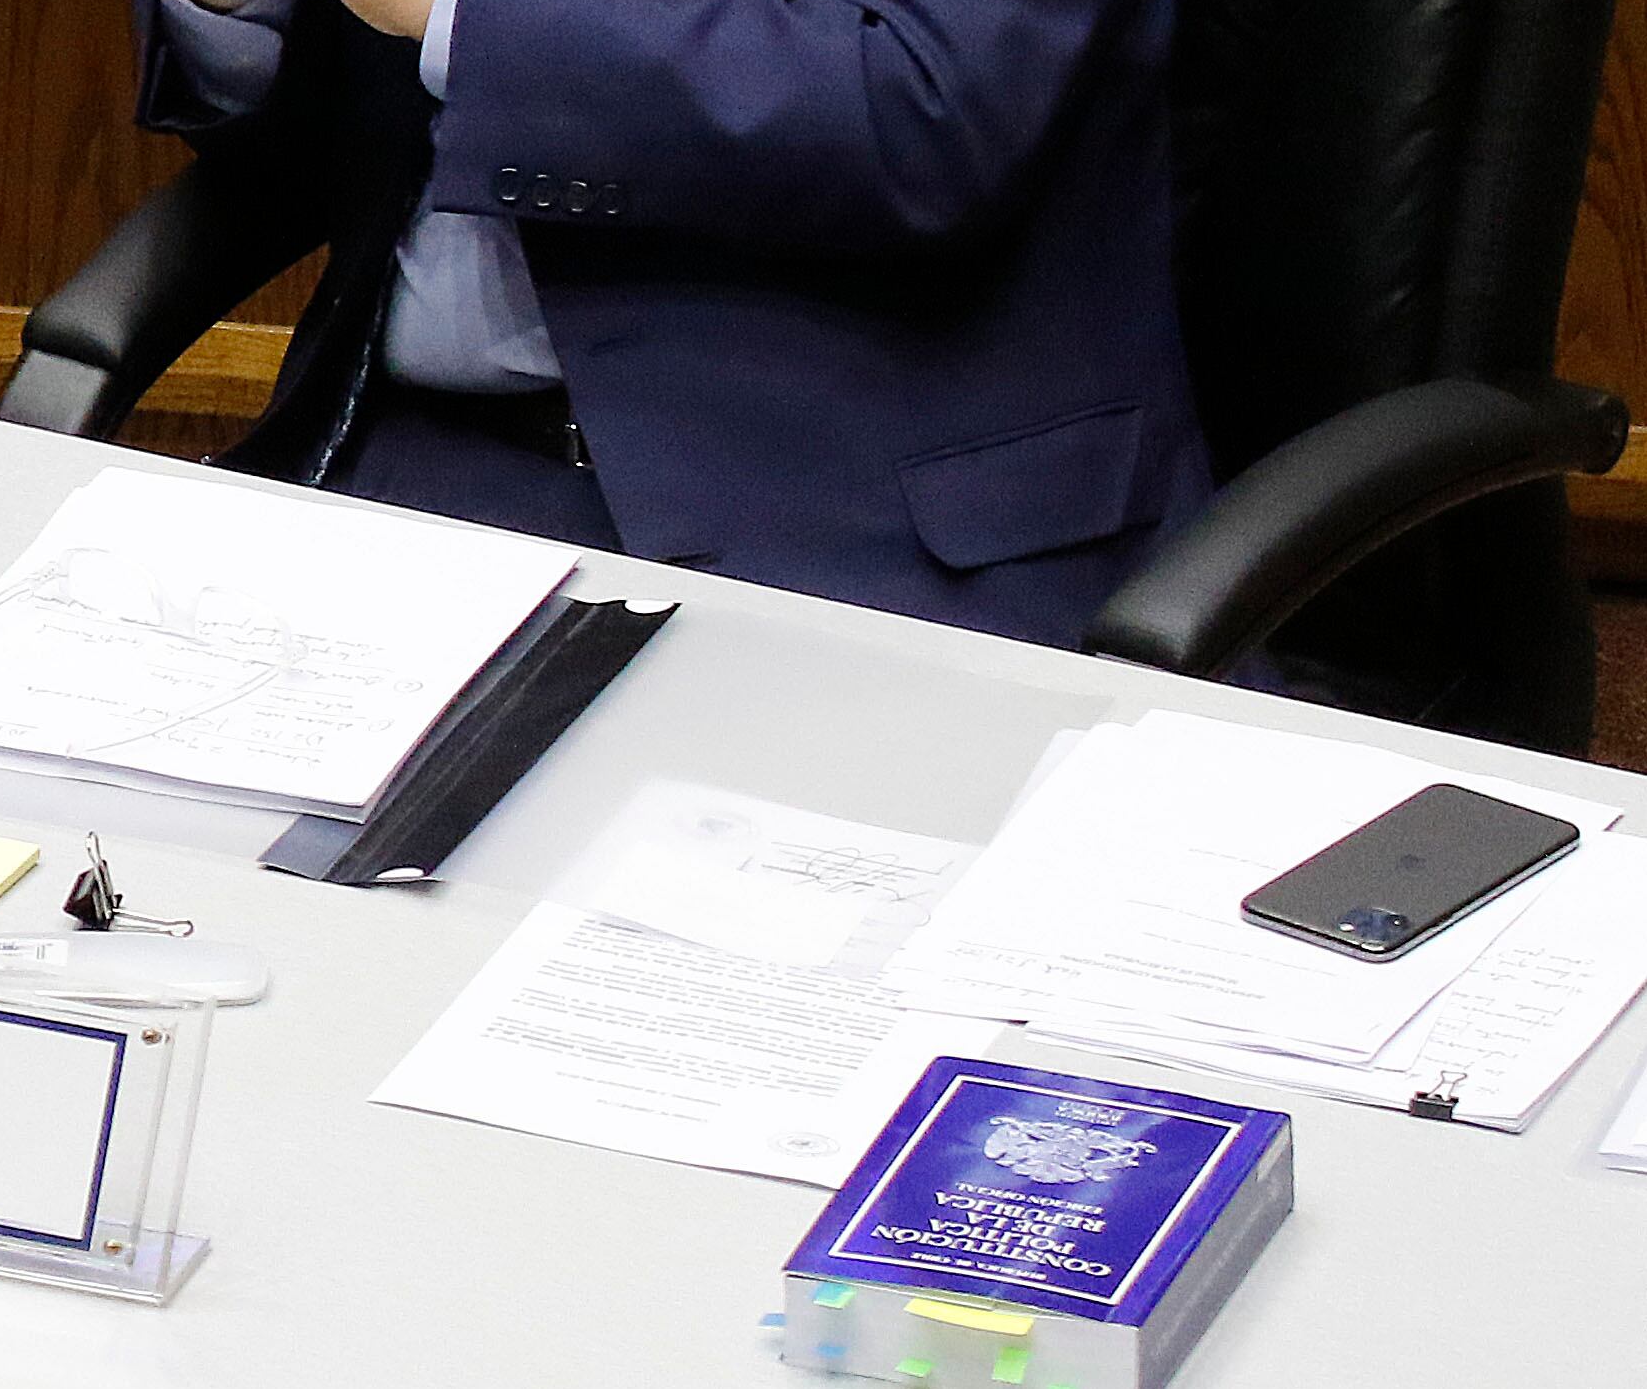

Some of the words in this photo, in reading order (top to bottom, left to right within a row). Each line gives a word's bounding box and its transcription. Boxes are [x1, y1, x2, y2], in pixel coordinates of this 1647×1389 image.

[935, 1191, 1107, 1233] REPUBLICA
[967, 1212, 1009, 1228] LA
[1010, 1219, 1056, 1236] DE
[870, 1224, 1112, 1277] CONSTITUCIÓN
[929, 1218, 1076, 1254] POLITICA
